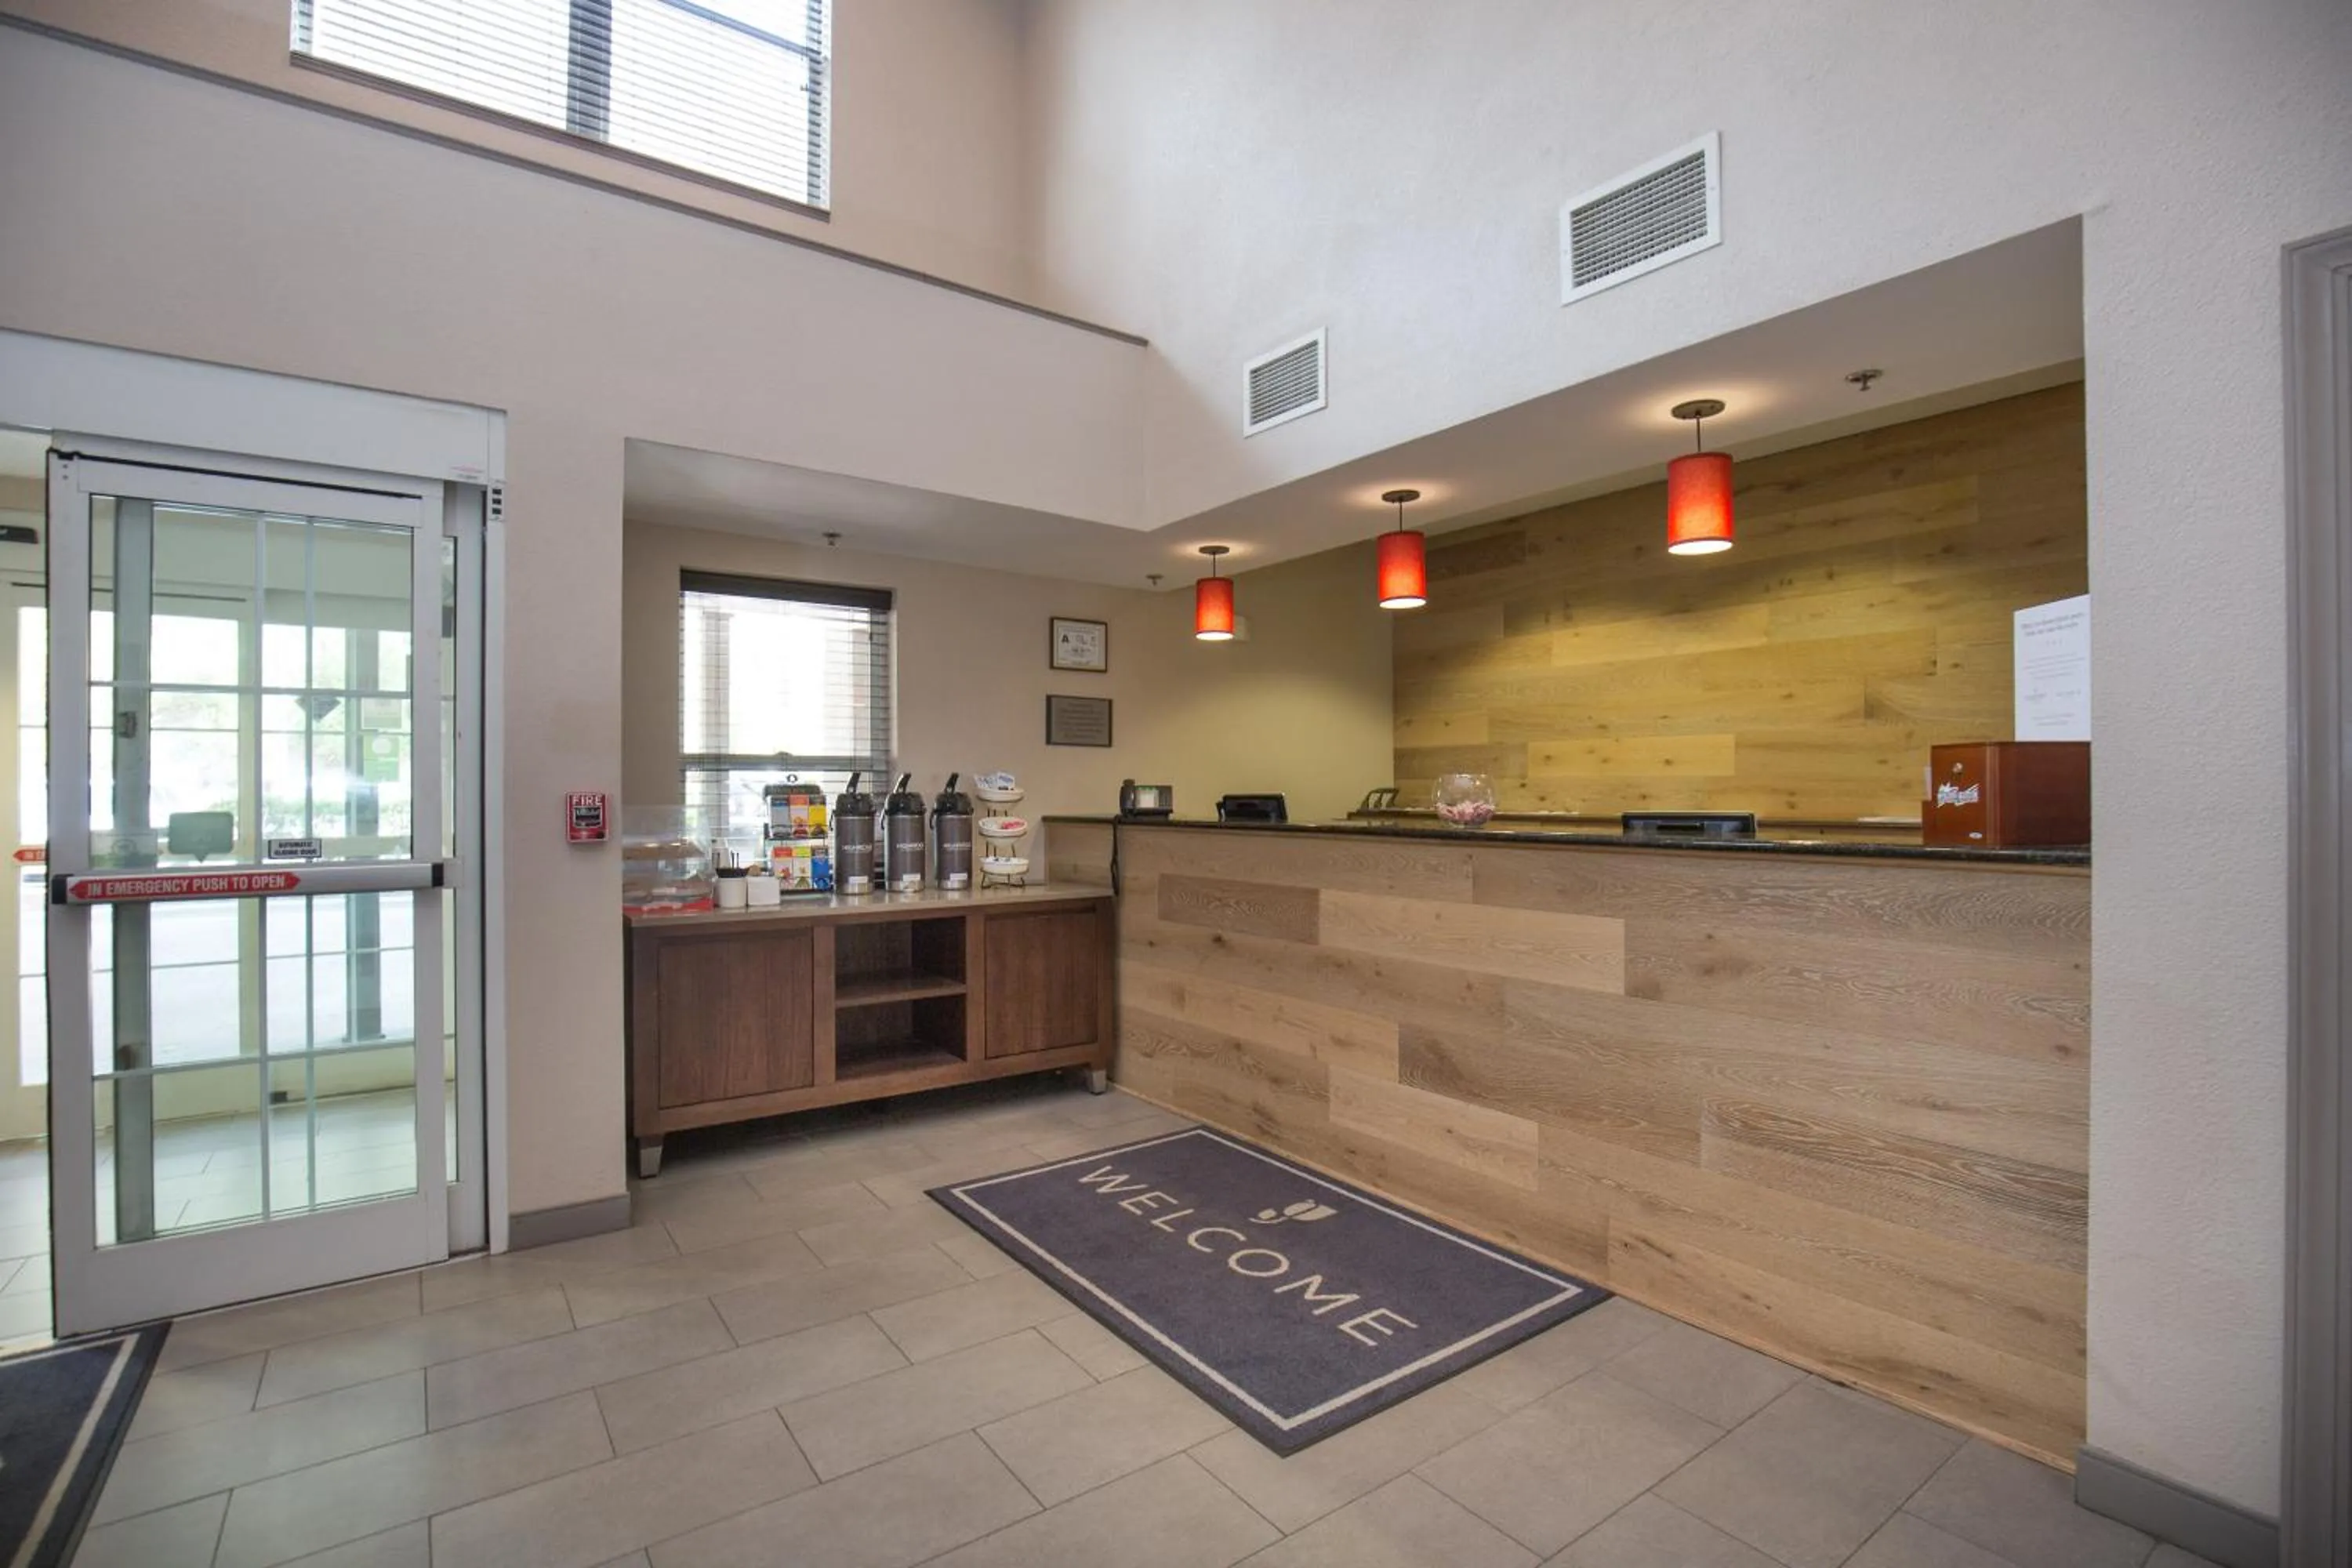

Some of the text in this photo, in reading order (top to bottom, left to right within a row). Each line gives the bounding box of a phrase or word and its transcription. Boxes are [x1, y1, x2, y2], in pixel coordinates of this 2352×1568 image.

[572, 795, 602, 805] FIRE
[88, 874, 286, 898] IN EMERGENCY PUSH TO OPEN
[1078, 1165, 1418, 1347] WELCOME
